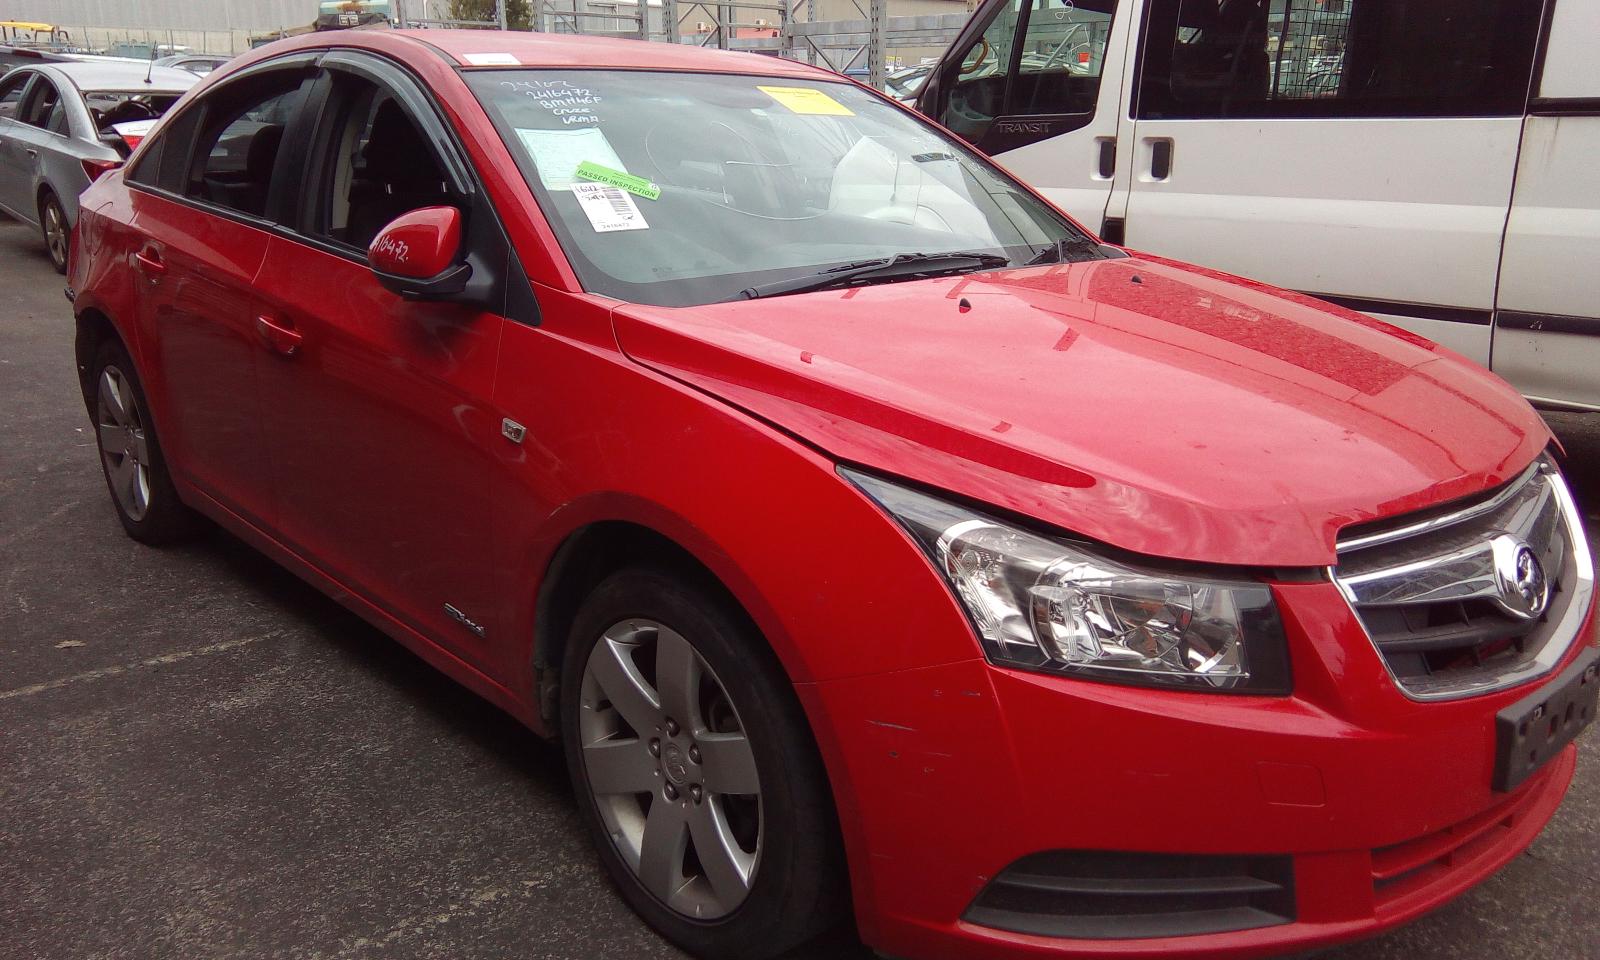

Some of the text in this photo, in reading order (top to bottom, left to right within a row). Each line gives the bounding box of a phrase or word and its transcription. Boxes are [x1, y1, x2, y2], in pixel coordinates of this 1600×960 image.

[526, 88, 592, 100] 2416472
[997, 122, 1052, 133] TRANSIT
[577, 169, 608, 183] PASSED
[609, 178, 656, 198] INSPECTION
